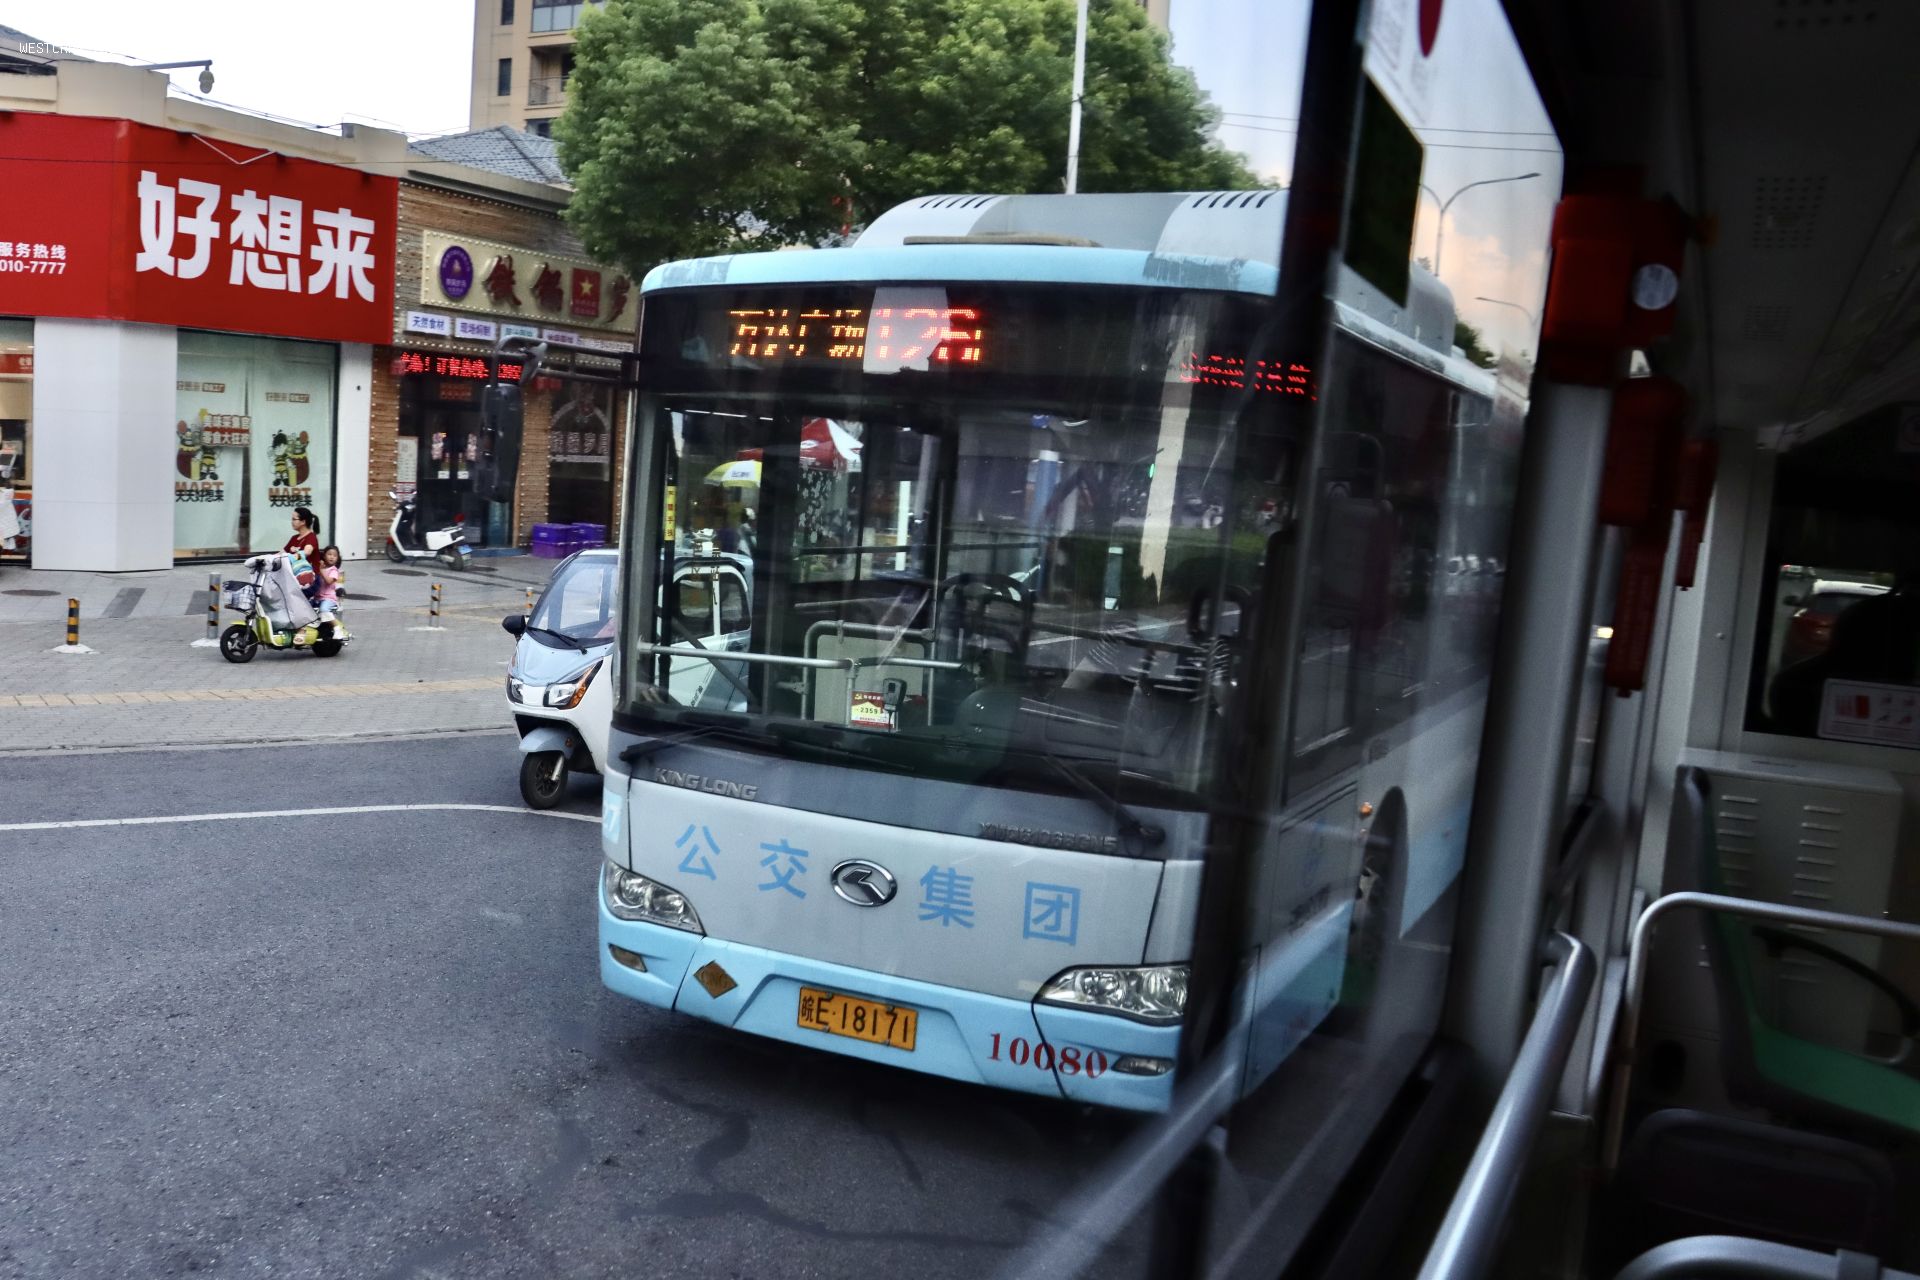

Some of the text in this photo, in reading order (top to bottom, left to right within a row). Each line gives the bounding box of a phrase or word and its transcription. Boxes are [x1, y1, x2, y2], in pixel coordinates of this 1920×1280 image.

[136, 170, 375, 303] 好想来
[656, 767, 757, 801] KING LONG
[675, 823, 1081, 946] 公交集团
[985, 1032, 1108, 1079] 10080
